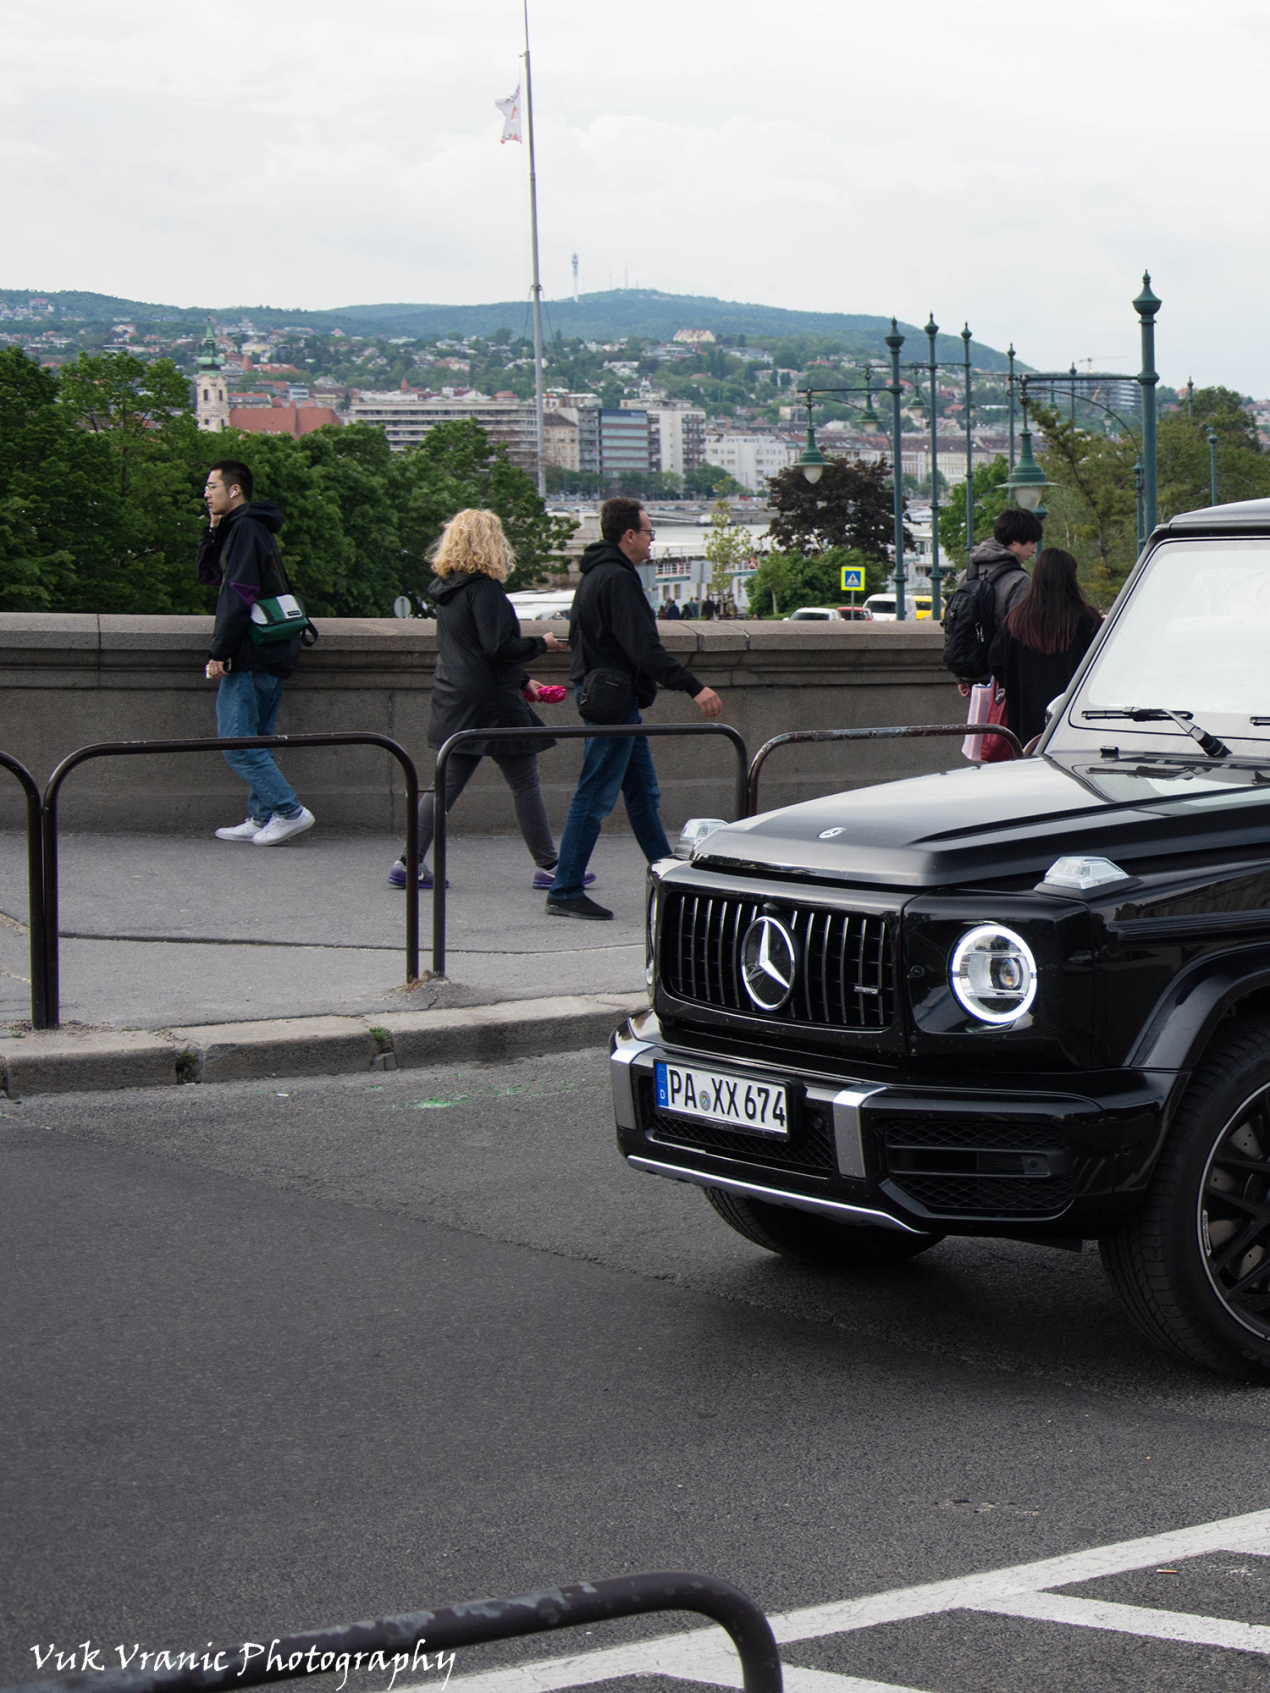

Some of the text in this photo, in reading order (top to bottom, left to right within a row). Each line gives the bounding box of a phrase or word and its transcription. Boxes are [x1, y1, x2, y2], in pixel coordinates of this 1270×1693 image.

[660, 1089, 666, 1100] D
[669, 1069, 786, 1127] PA XX 674
